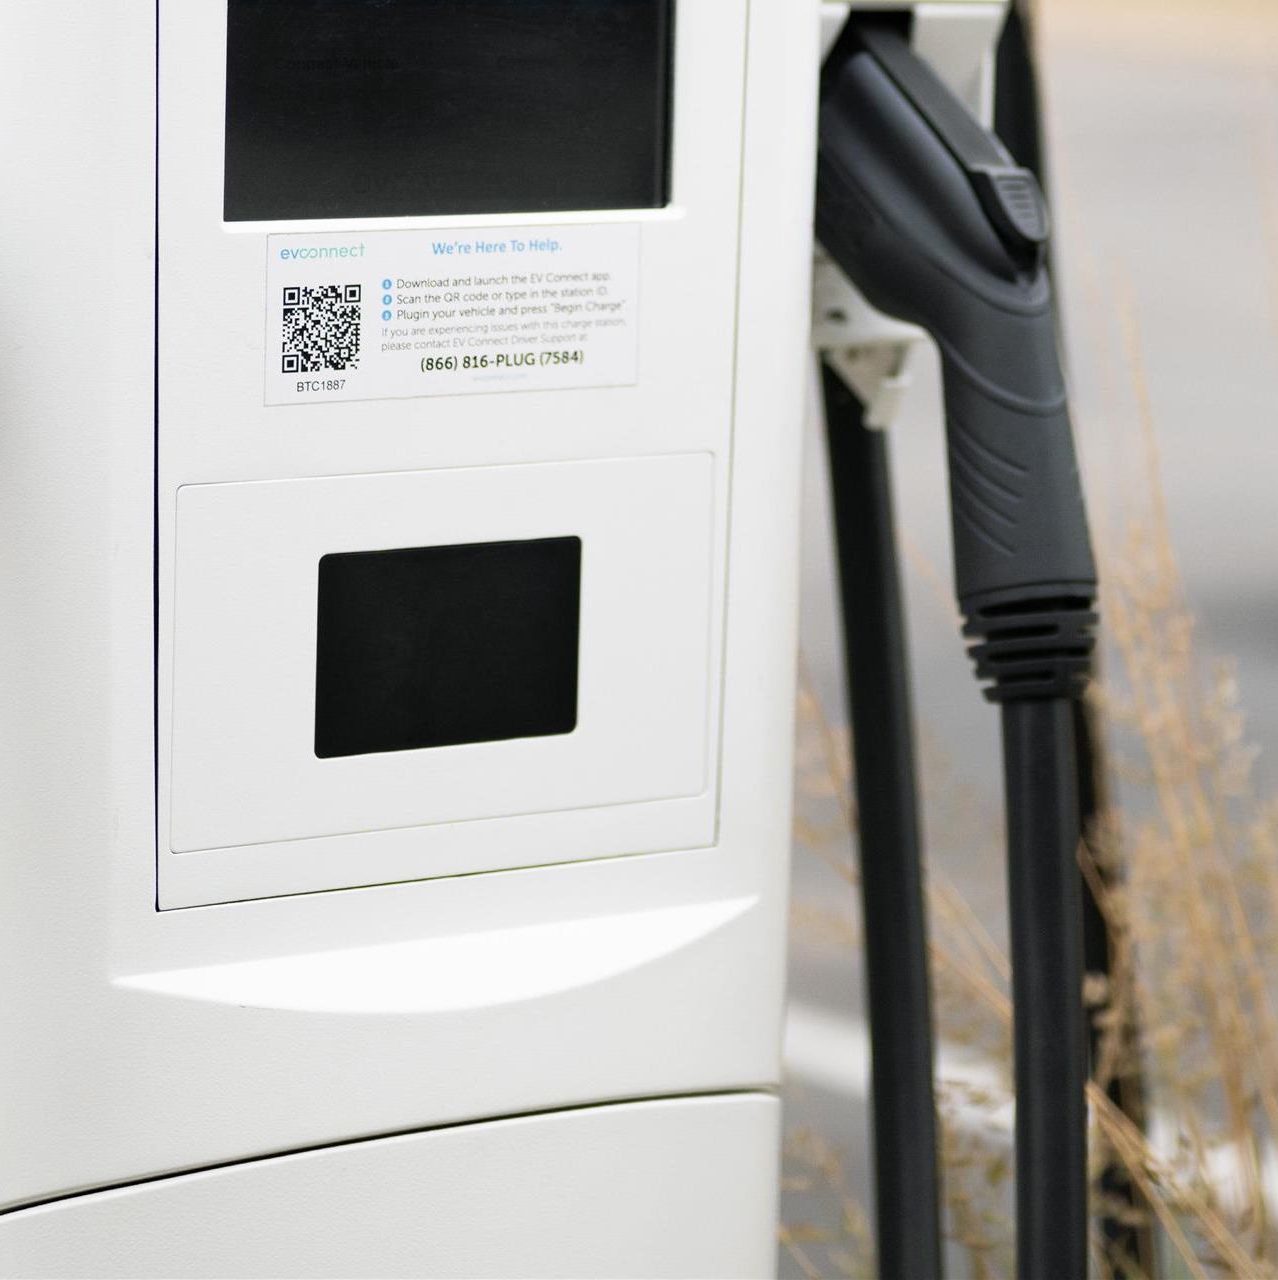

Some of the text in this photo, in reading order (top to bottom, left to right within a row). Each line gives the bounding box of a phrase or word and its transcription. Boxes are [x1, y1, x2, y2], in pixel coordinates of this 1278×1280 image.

[432, 238, 563, 256] We're Here To Help.
[396, 277, 450, 289] Download
[452, 276, 471, 287] and
[474, 275, 508, 287] launch
[511, 274, 527, 285] the
[529, 273, 544, 284] EV
[545, 272, 589, 283] Connect
[396, 294, 421, 305] Scan
[424, 293, 441, 304] the
[443, 292, 461, 303] QR
[463, 291, 489, 302] code
[491, 292, 503, 301] or
[505, 291, 527, 302] type
[529, 289, 539, 299] in
[542, 288, 558, 298] the
[396, 309, 430, 321] Plugin
[432, 310, 456, 321] your
[459, 306, 496, 318] vehicle
[498, 305, 518, 316] and
[521, 305, 547, 316] press
[390, 328, 409, 339] you
[420, 349, 585, 373] (866) 816-PLUG (7584)
[296, 379, 346, 393] BTC1887
